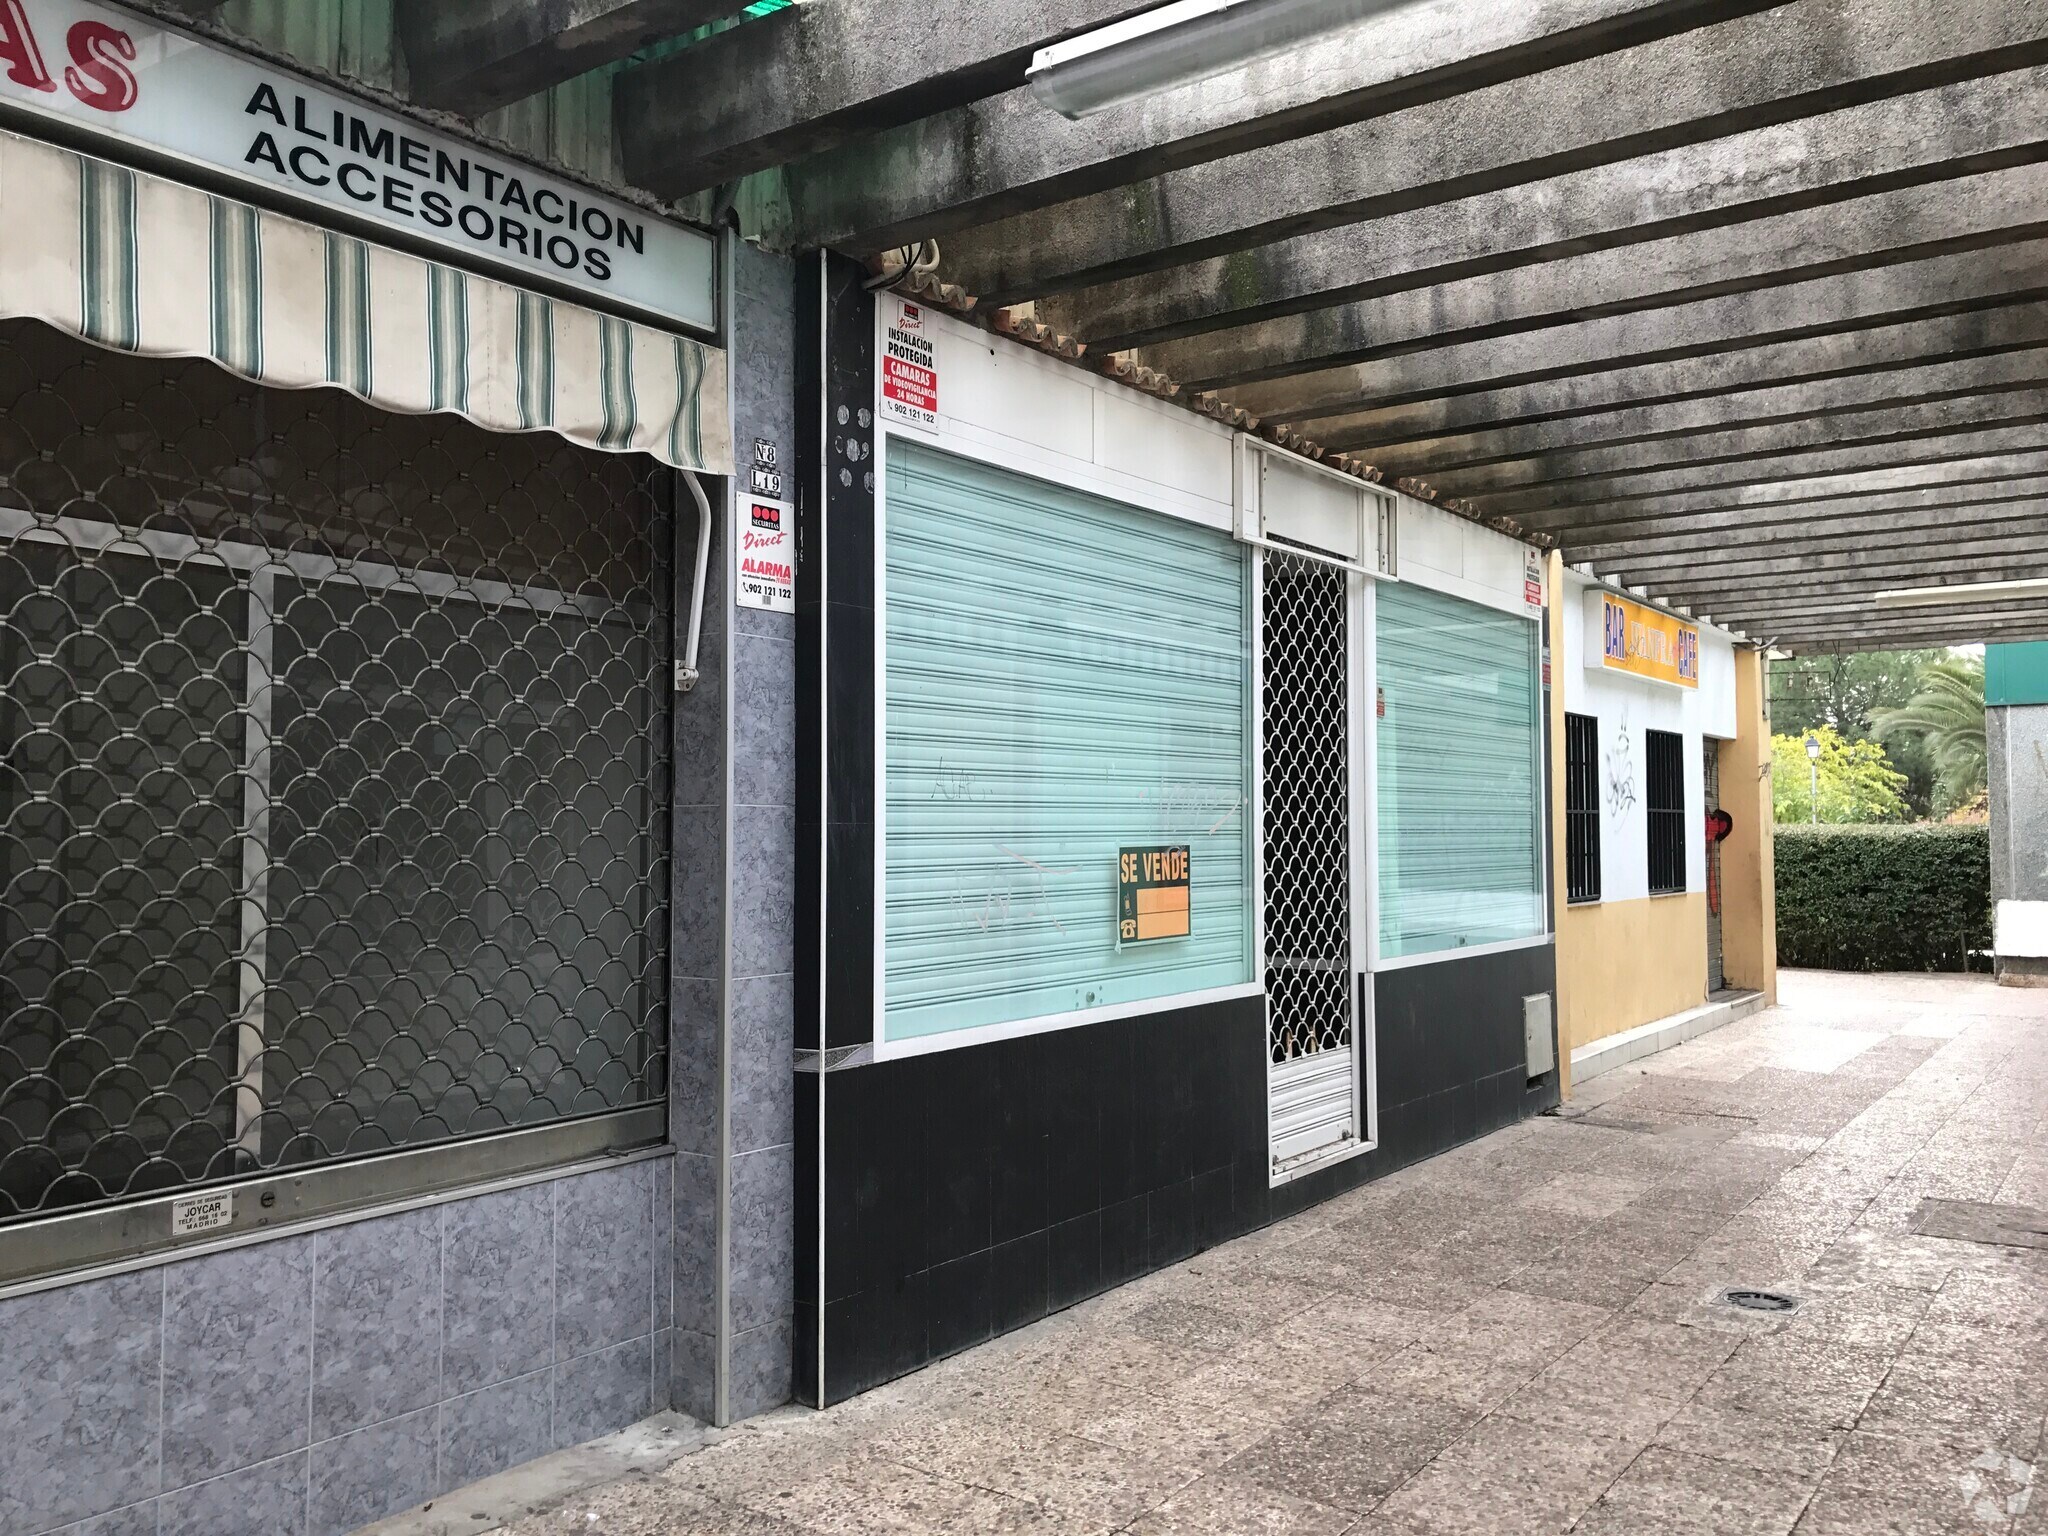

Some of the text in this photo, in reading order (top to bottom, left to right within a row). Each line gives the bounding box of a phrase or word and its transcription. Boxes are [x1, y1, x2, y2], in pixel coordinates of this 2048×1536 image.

[245, 83, 644, 255] ALIMENTACION
[243, 132, 612, 281] ACCESORIOS
[889, 327, 933, 353] INSTALACION
[888, 341, 933, 369] PROTEGIDA
[891, 362, 930, 386] CAMARAS
[884, 374, 936, 399] DE VIDEOVIGILANCIA
[897, 389, 925, 406] 24 HORAS
[895, 404, 907, 415] 902
[909, 408, 920, 419] 121
[923, 413, 935, 424] 122
[753, 519, 780, 530] SECURITAS
[742, 530, 787, 551] Direct
[741, 558, 791, 579] ALARMA
[749, 584, 791, 599] 902 121 122
[1605, 601, 1625, 660] BAR
[1678, 627, 1697, 679] CAFE
[1121, 851, 1188, 884] SE VENDE
[185, 1202, 221, 1218] JOYCAR
[187, 1219, 218, 1230] MADRID
